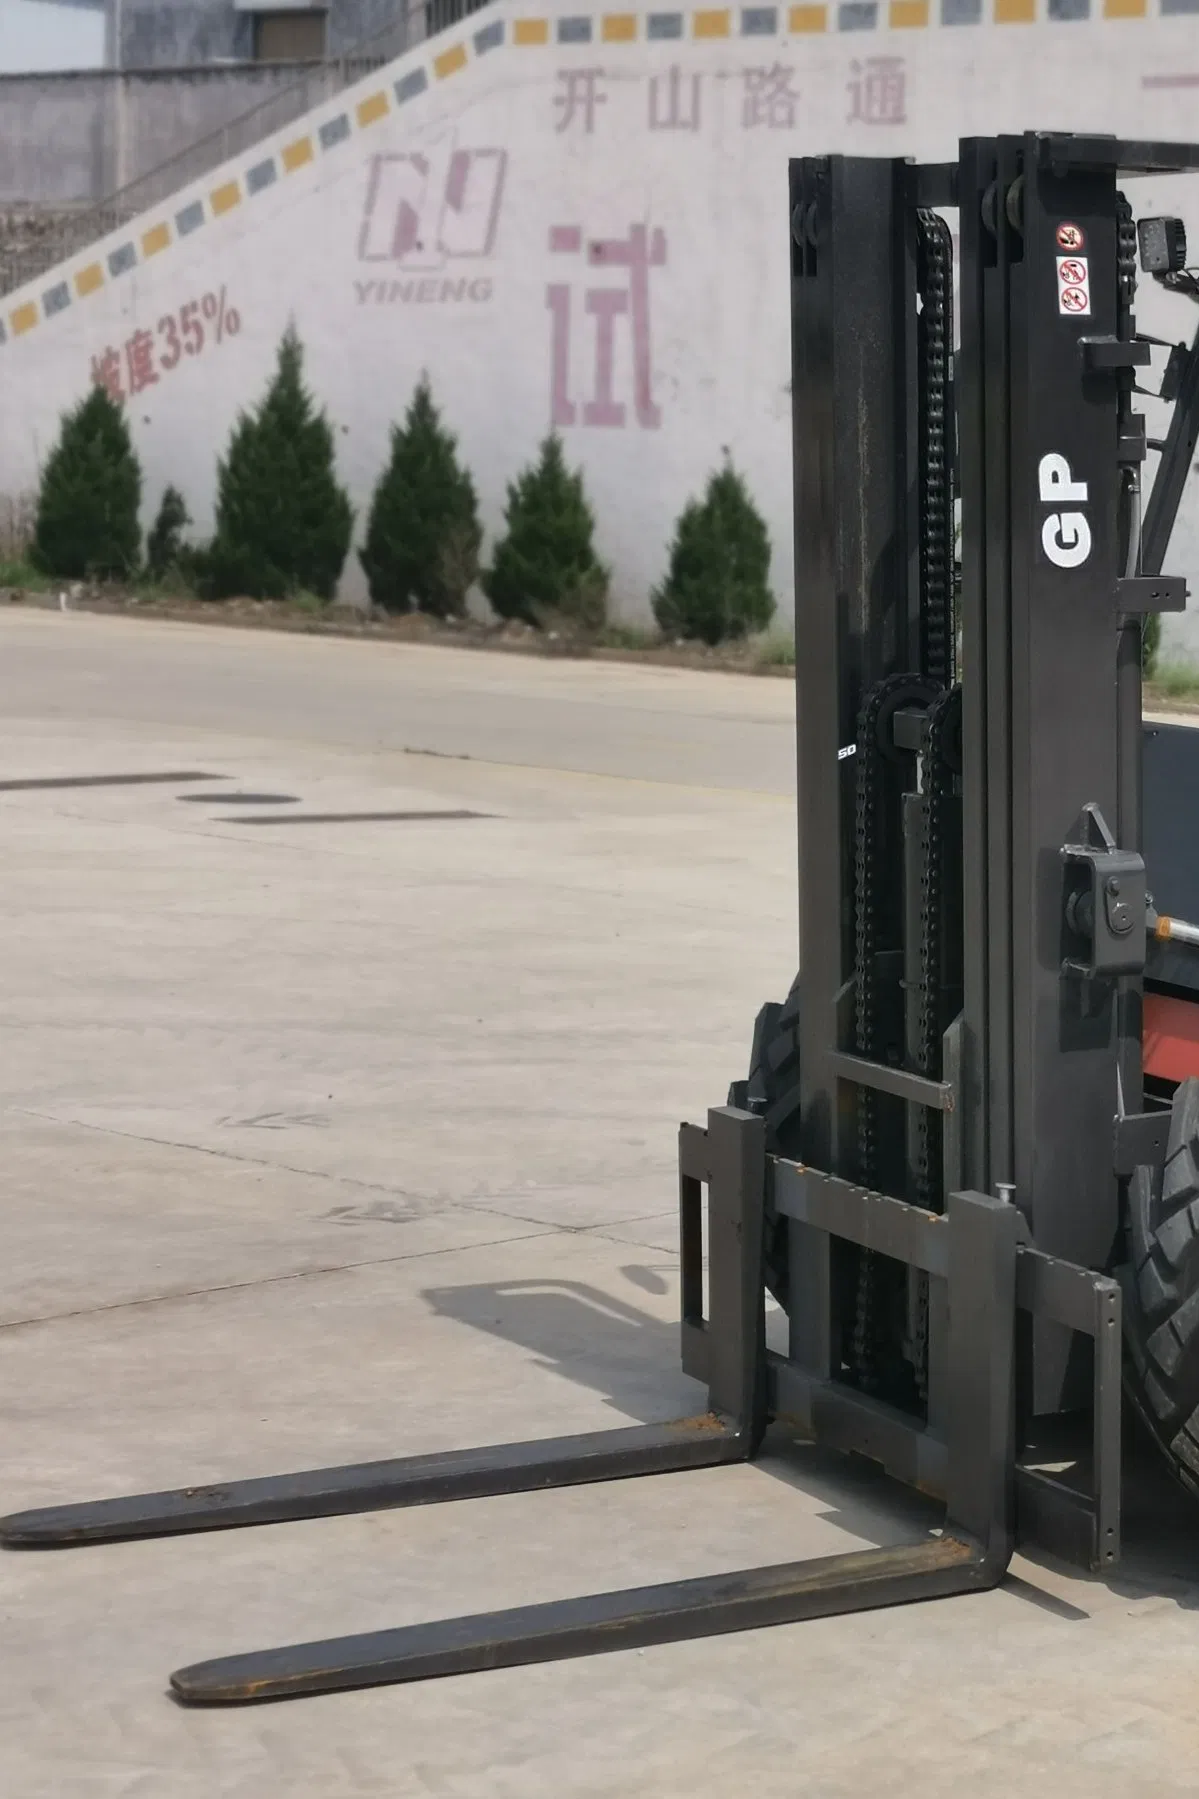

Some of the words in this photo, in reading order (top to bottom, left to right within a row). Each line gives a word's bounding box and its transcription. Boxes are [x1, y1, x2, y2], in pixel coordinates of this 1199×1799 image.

[552, 55, 908, 134] 开山路通
[352, 277, 494, 304] YINENG
[545, 223, 667, 431] 试
[1038, 453, 1092, 568] GP
[837, 743, 857, 760] 50
